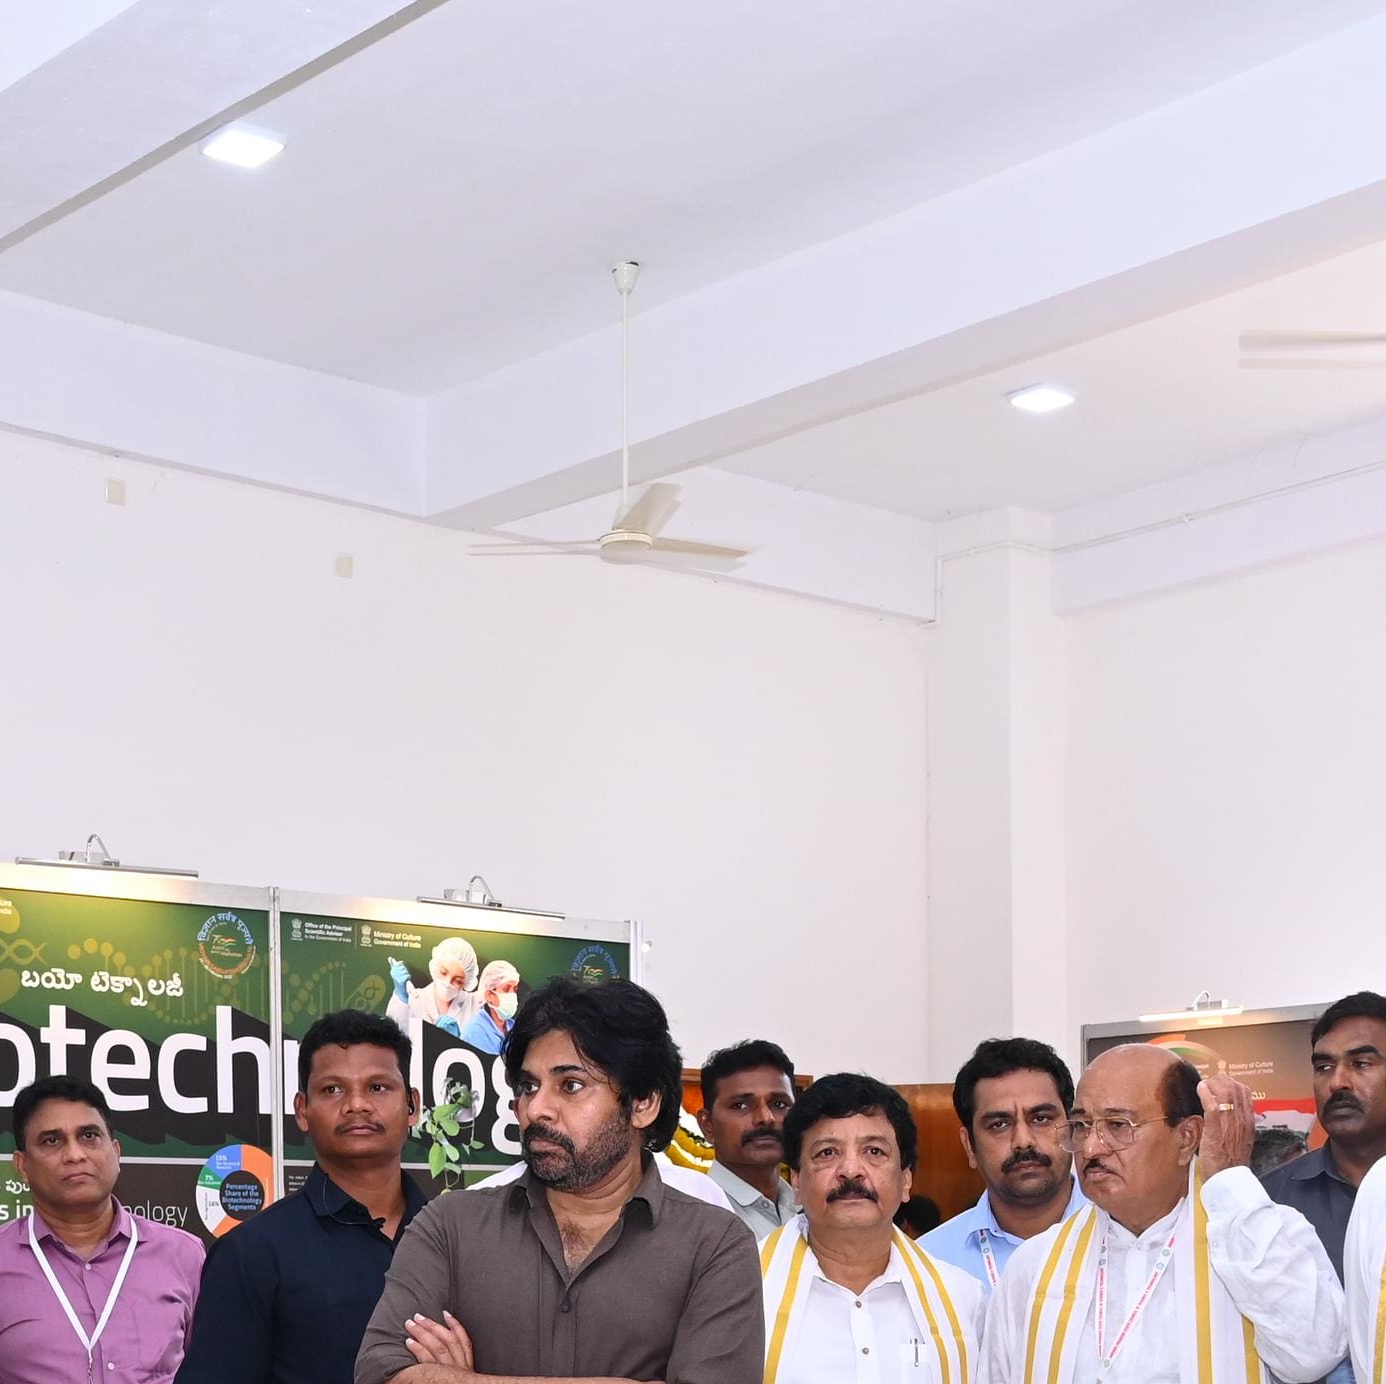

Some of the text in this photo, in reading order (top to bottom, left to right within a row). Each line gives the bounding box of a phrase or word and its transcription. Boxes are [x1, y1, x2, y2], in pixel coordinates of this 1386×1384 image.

[21, 967, 185, 1007] బయో టెక్నాలజీ
[1254, 1060, 1274, 1068] Culture
[225, 1183, 258, 1193] Percentage
[221, 1197, 262, 1205] Biotechnology
